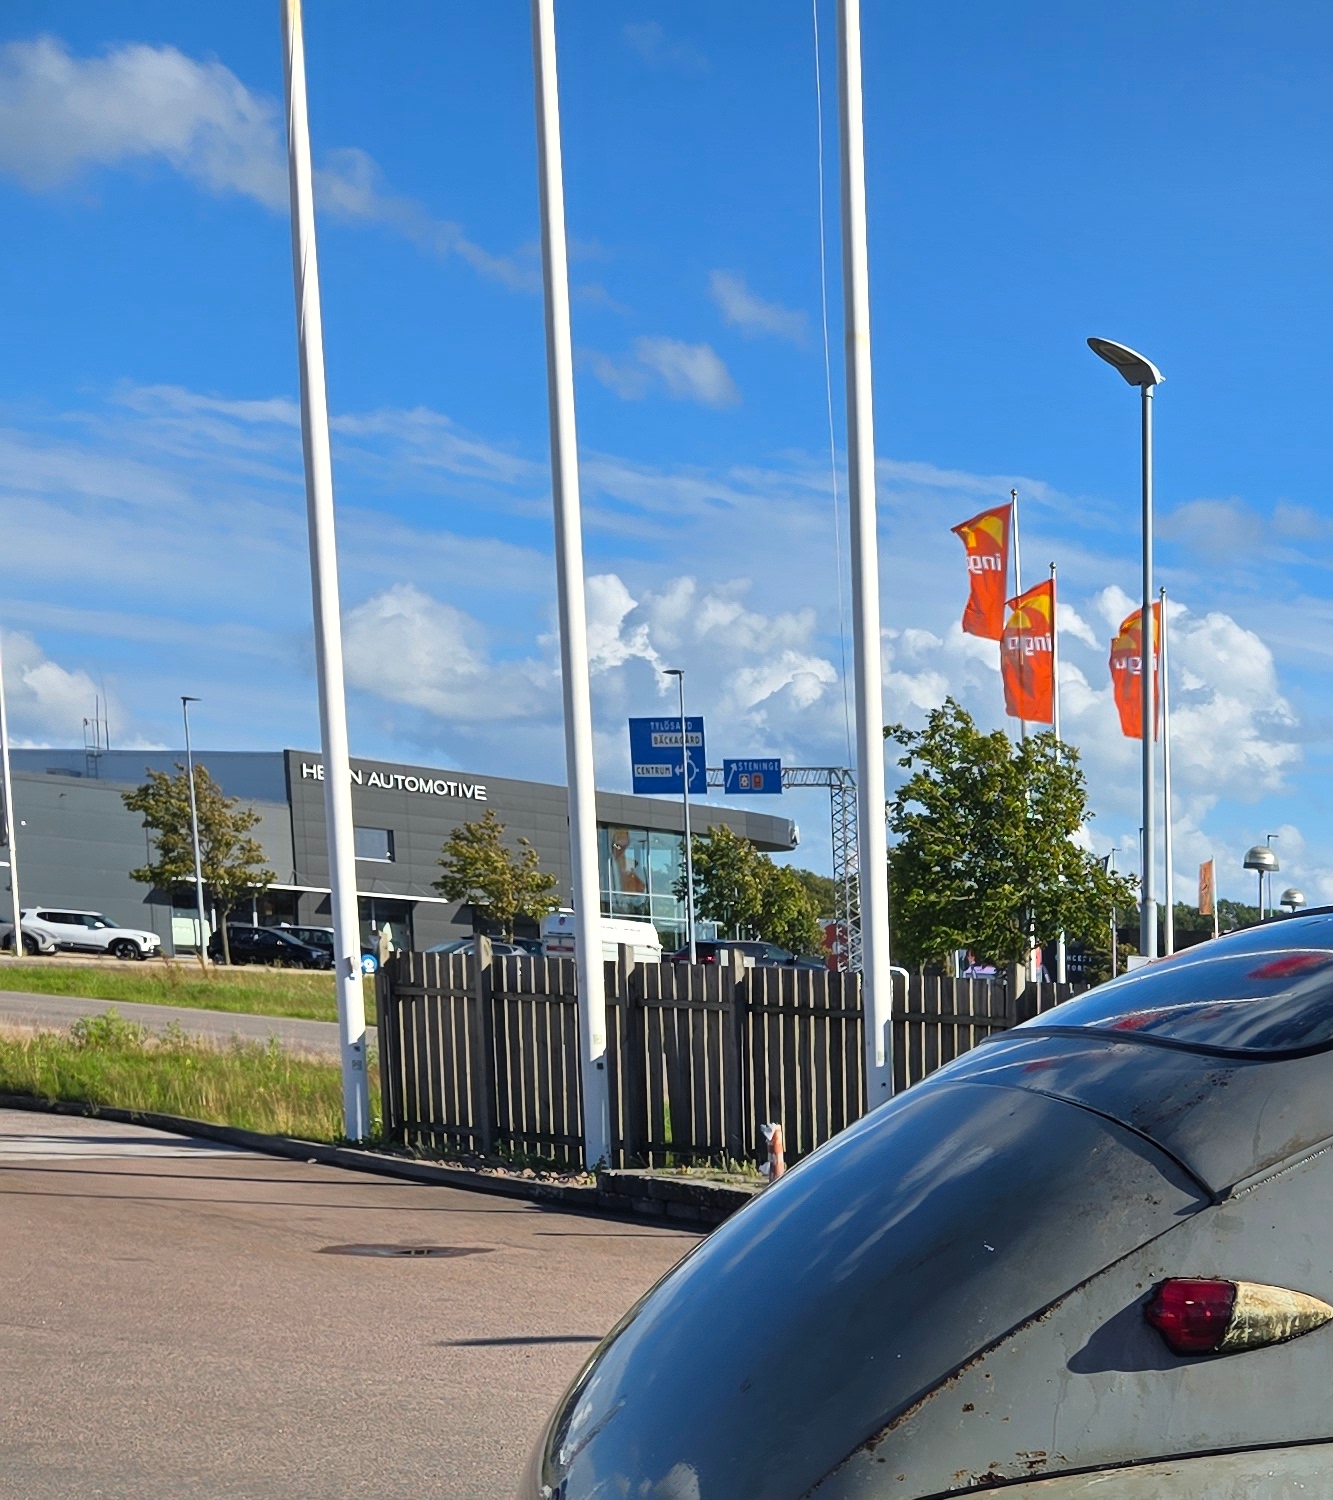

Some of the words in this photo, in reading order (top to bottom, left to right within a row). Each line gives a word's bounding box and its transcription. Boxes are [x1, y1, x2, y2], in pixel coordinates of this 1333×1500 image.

[650, 720, 693, 731] TYLÖSAD
[636, 766, 671, 775] CENTRUM
[738, 761, 779, 771] STENINGE
[302, 762, 363, 785] HEN
[367, 771, 488, 801] AUTOMOTIVE
